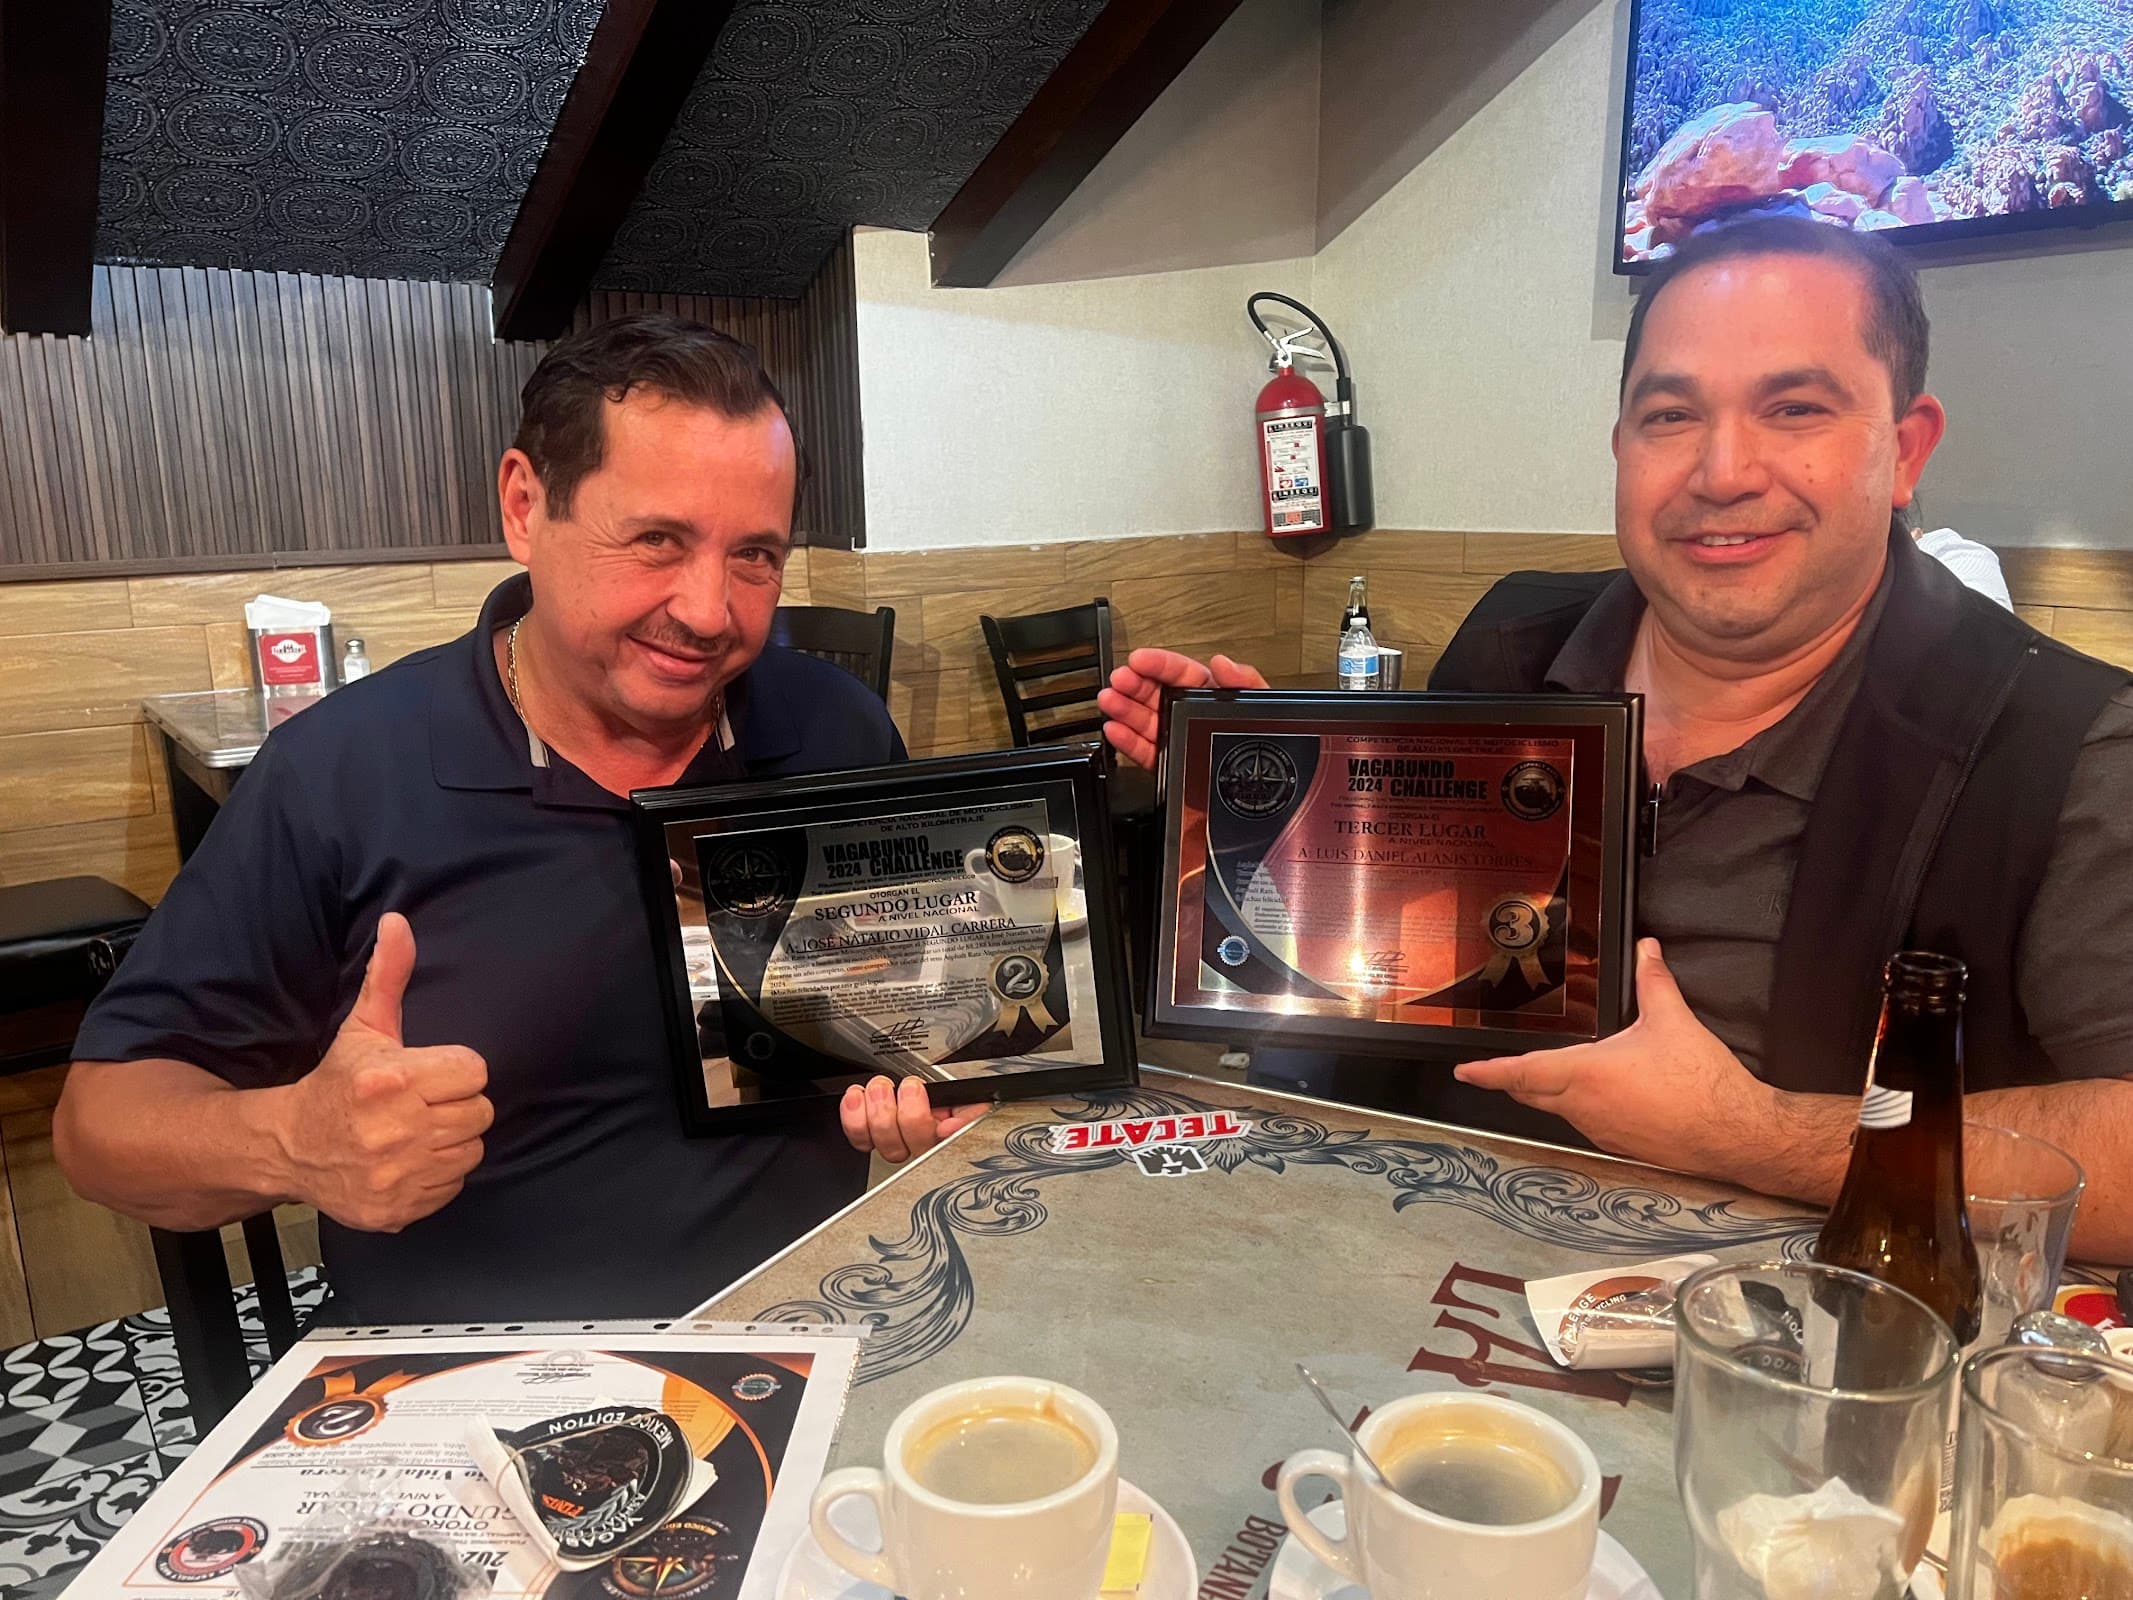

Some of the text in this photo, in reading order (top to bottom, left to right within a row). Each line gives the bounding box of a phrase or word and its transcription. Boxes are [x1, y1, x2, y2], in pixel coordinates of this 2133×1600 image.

[1347, 758, 1454, 778] VAGABUNDO
[1348, 778, 1488, 800] 2024 CHALLENGE
[880, 824, 894, 833] DE
[895, 822, 919, 832] ALTO
[898, 809, 947, 823] NACIONAL
[949, 808, 962, 817] DE
[1334, 820, 1486, 839] TERCER LUGAR
[822, 835, 930, 864] VAGABUNDO
[1316, 847, 1349, 859] LUIS
[1353, 849, 1407, 862] DANIEL
[827, 861, 862, 879] 2024
[869, 849, 965, 877] CHALLENGE
[869, 889, 909, 899] OTORGAN
[911, 887, 920, 895] EL
[815, 891, 978, 921] SEGUNDO LUGAR
[889, 911, 919, 921] NIVEL
[923, 905, 980, 917] NACIONAL
[844, 929, 900, 946] NATALIO
[904, 924, 948, 940] VIDAL
[952, 917, 1017, 934] CARRERA
[1494, 905, 1534, 946] 3
[1003, 958, 1036, 994] 2
[1063, 1114, 1243, 1149] TECATE
[549, 1411, 675, 1450] MEXICO EDITION
